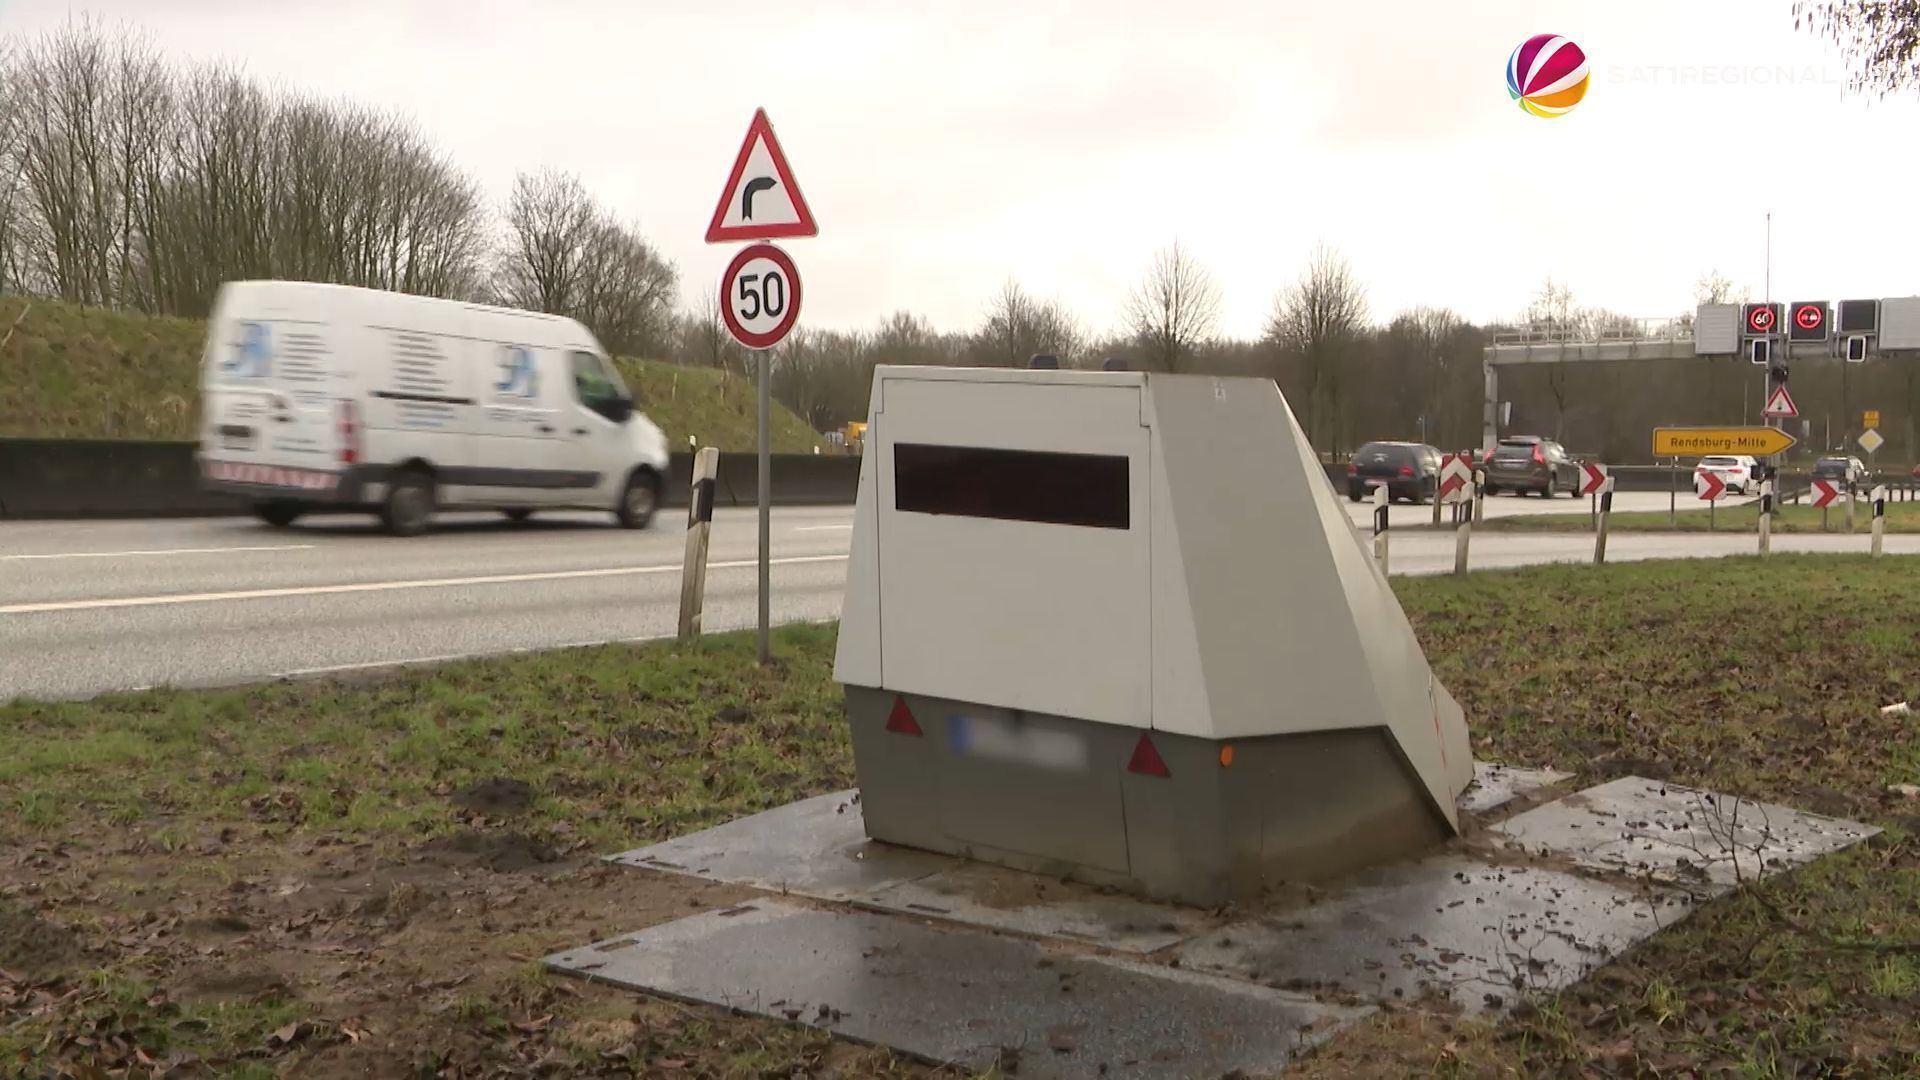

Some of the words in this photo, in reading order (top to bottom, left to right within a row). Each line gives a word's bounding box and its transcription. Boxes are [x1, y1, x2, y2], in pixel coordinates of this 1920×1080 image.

[739, 271, 784, 320] 50
[1755, 312, 1769, 324] 60
[1671, 437, 1767, 449] Rendsburg-Mitte
